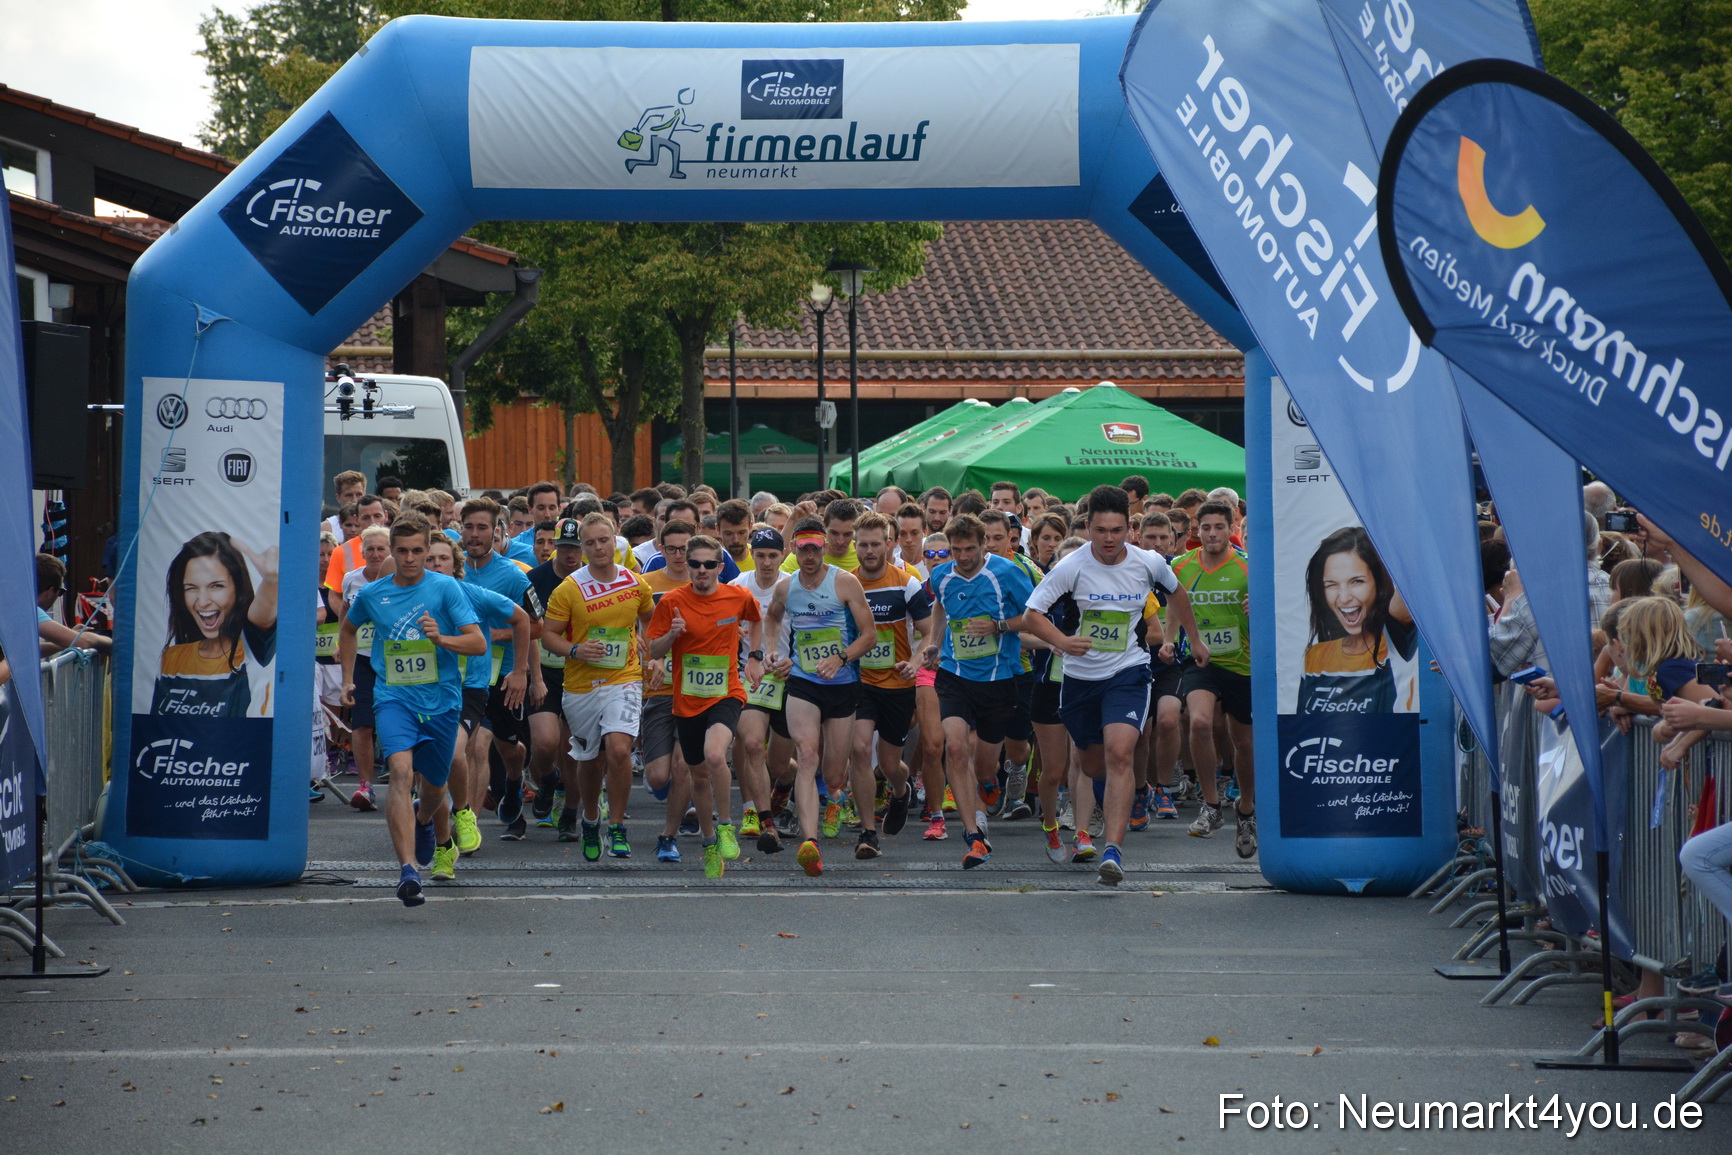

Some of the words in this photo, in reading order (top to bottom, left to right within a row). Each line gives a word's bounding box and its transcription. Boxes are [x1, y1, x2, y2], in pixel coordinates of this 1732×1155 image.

[763, 83, 837, 97] Fischer
[706, 120, 930, 162] firmenlauf
[706, 164, 799, 179] neumarkt
[269, 199, 392, 225] Fischer
[279, 225, 381, 238] AUTOMOBILE
[821, 402, 832, 425] WC
[206, 424, 234, 433] Audi
[1080, 448, 1177, 458] Neumarkter
[227, 459, 249, 476] FIAT
[1065, 456, 1198, 469] Lammsbräu
[152, 477, 195, 486] SEAT
[1286, 474, 1331, 484] SEAT
[1089, 593, 1142, 601] DELPHI
[586, 598, 614, 613] MAX
[394, 611, 413, 628] Schick
[412, 603, 425, 613] Bau
[1089, 624, 1119, 640] 294
[1204, 631, 1232, 645] 145
[959, 634, 987, 648] 522
[598, 642, 620, 657] 91
[803, 644, 839, 660] 1336
[394, 657, 426, 673] 819
[687, 670, 724, 686] 1028
[153, 756, 249, 776] Fischer
[1303, 754, 1400, 774] Fischer
[160, 777, 241, 787] AUTOMOBILE
[1311, 776, 1392, 785] AUTOMOBILE
[175, 797, 197, 809] und
[198, 795, 219, 806] das
[1327, 795, 1349, 807] und
[1351, 792, 1371, 804] das
[201, 808, 231, 822] fährt
[233, 806, 258, 816] mit!
[1355, 805, 1384, 820] fährt
[1387, 802, 1410, 813] mit!
